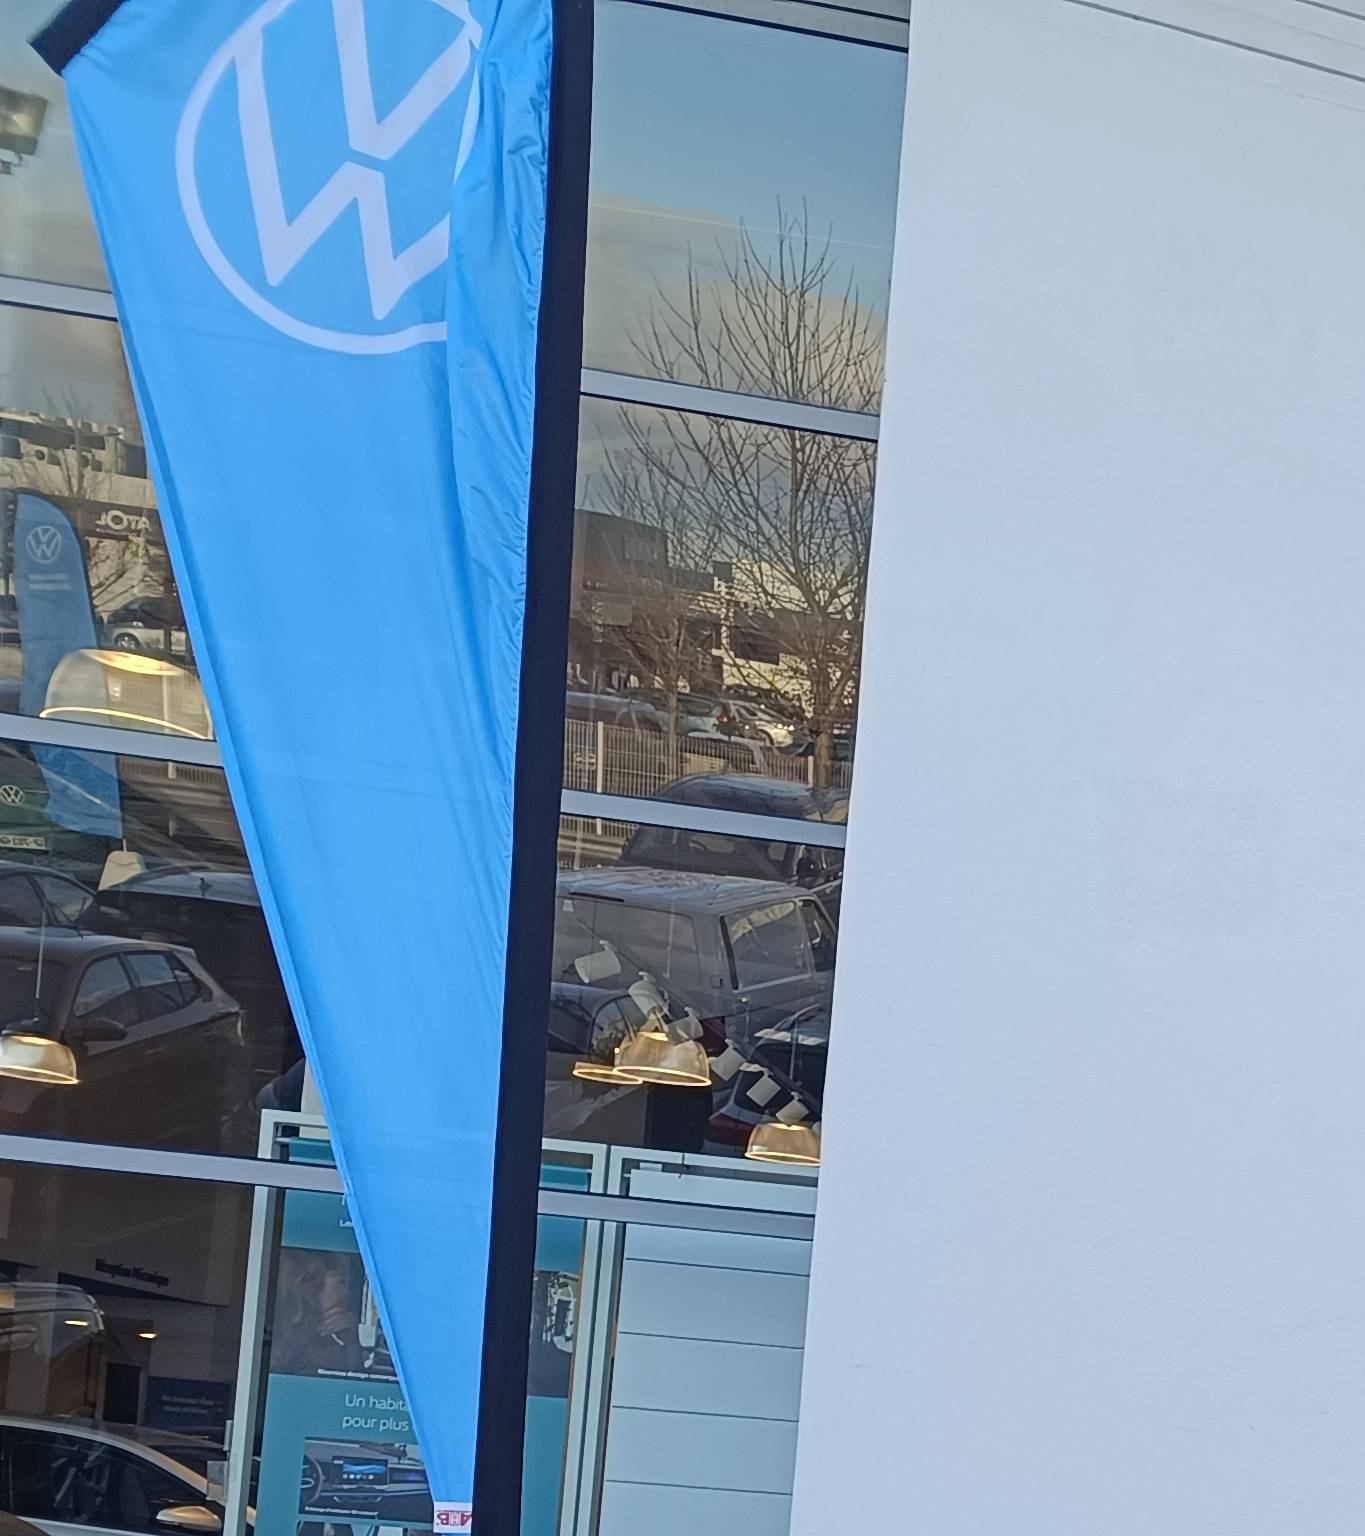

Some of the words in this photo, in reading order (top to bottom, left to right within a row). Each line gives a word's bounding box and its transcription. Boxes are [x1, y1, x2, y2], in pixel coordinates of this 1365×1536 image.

[344, 1394, 366, 1408] Un
[342, 1416, 377, 1430] pour
[379, 1418, 409, 1432] plus
